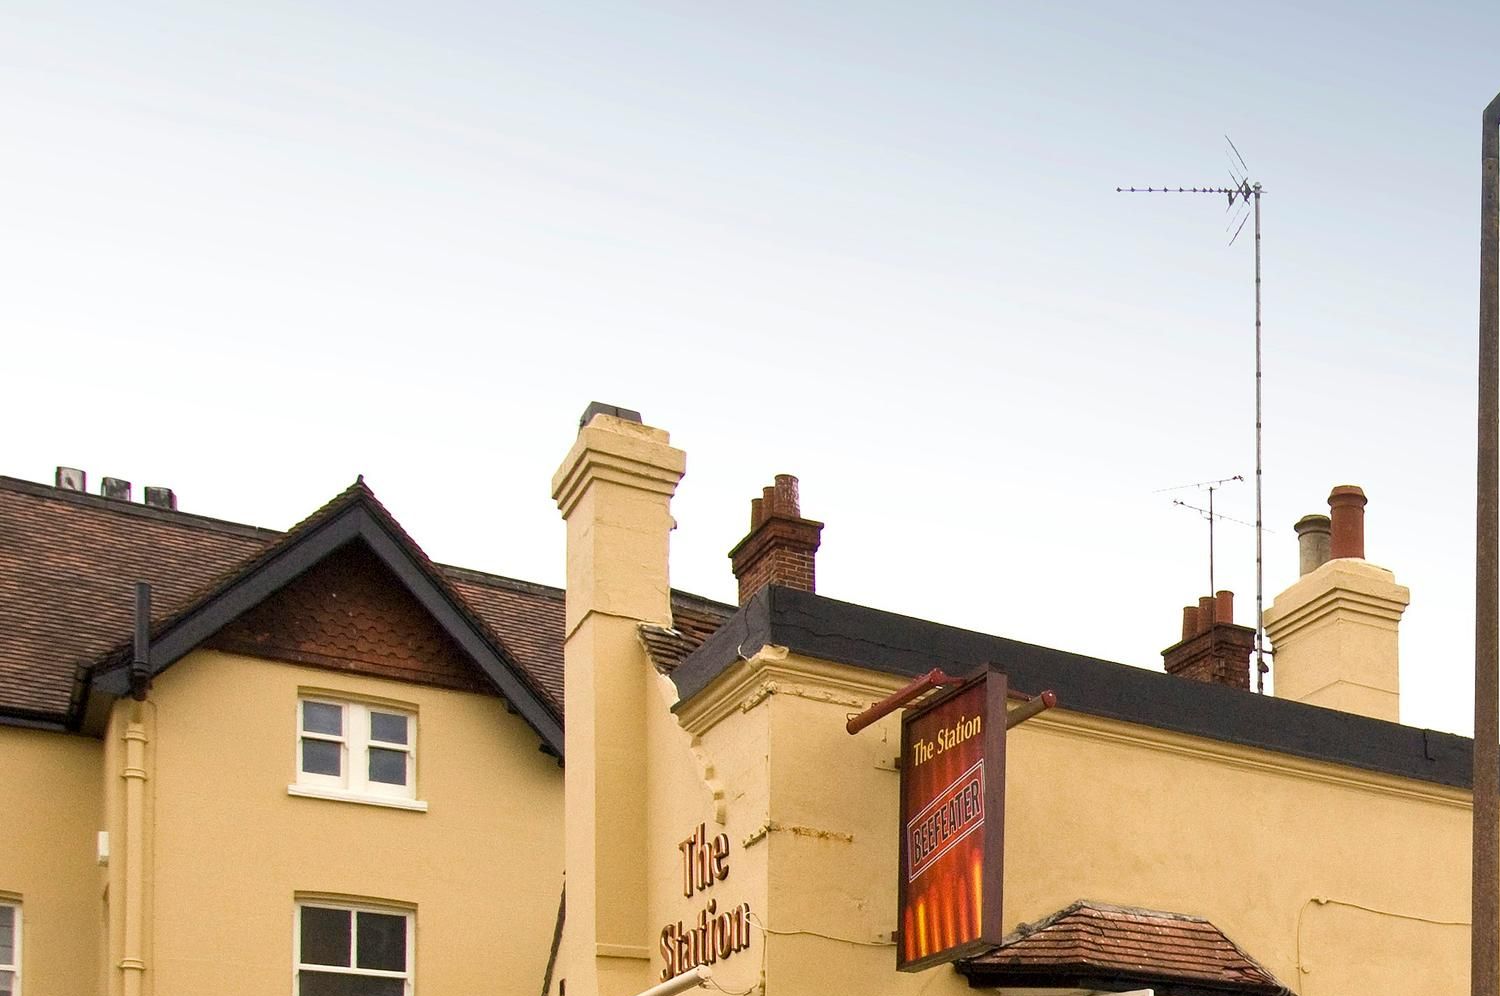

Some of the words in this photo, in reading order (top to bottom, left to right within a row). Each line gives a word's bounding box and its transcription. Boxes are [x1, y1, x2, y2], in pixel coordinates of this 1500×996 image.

[914, 738, 934, 767] The
[937, 715, 981, 755] Station
[678, 822, 730, 898] The
[913, 778, 981, 867] BEEFEATER
[660, 898, 750, 982] Station
